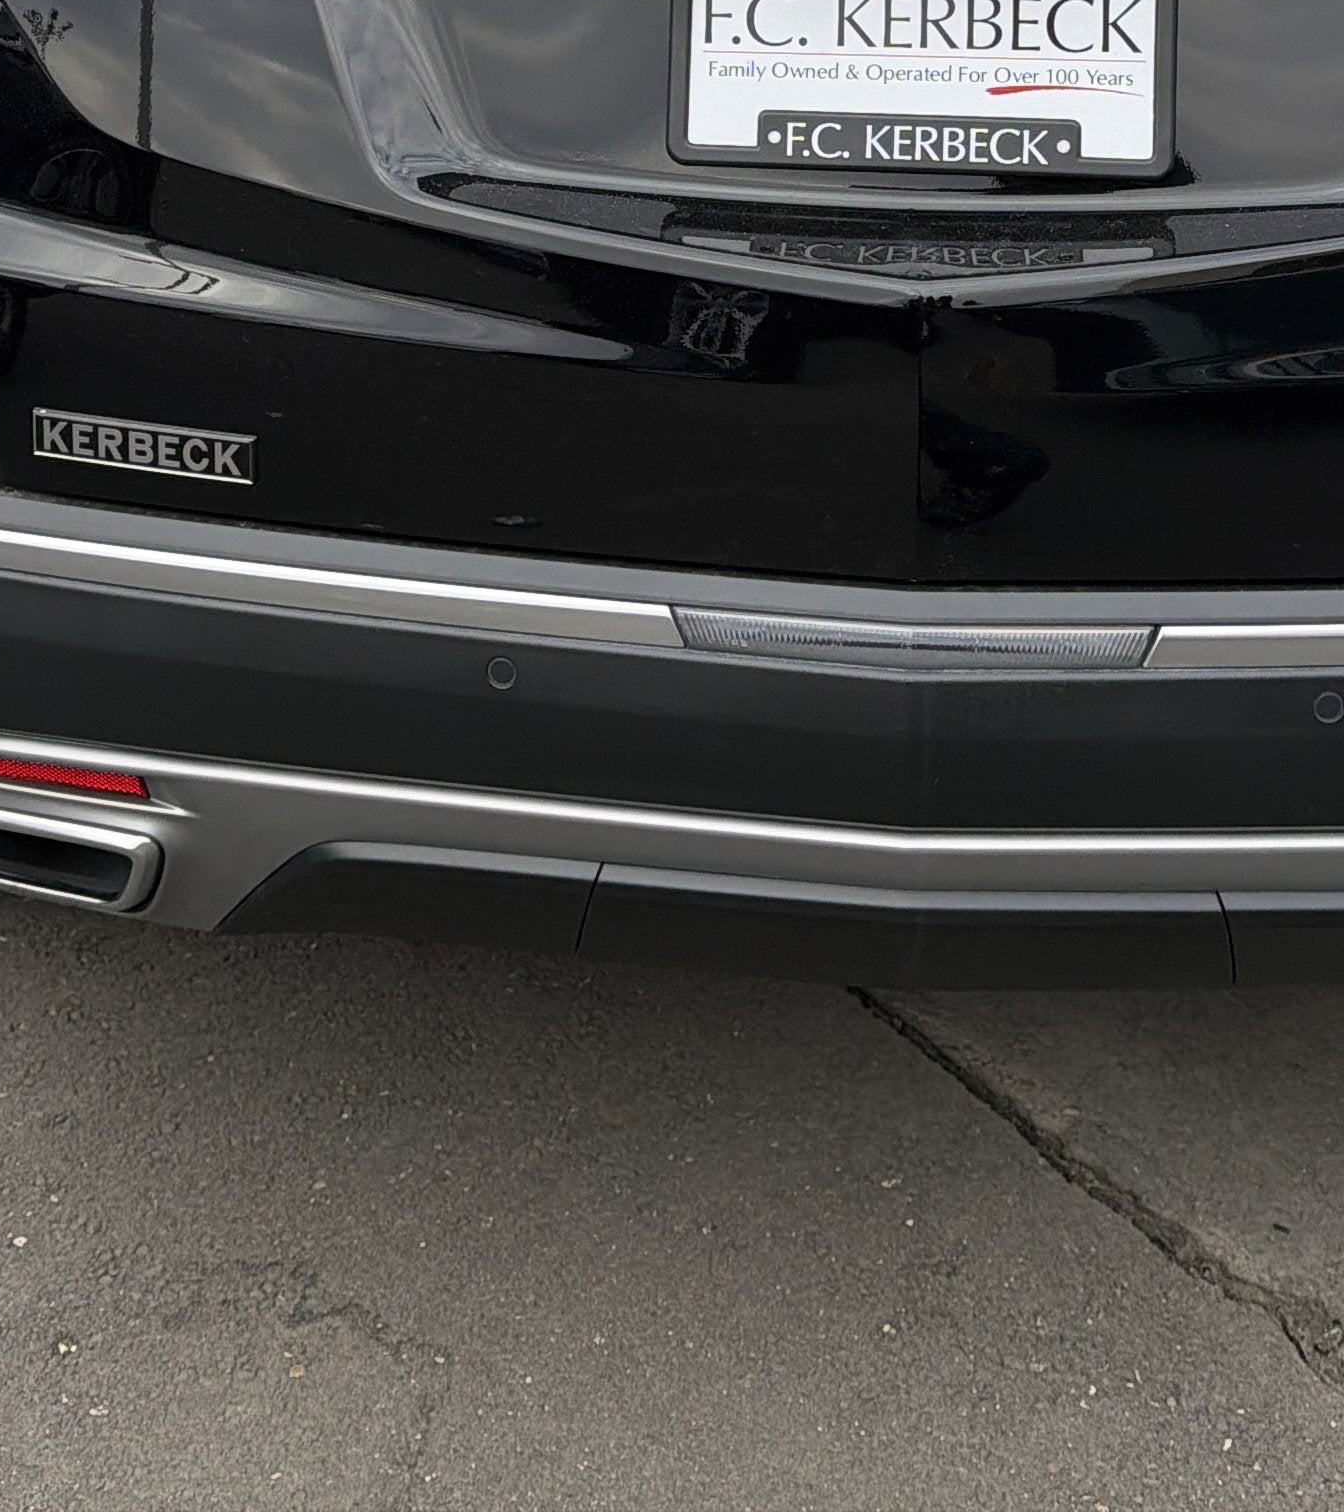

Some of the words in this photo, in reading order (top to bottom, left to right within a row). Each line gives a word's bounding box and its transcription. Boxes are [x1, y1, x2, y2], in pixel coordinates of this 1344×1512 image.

[708, 60, 766, 81] Family
[771, 61, 839, 80] Owned
[846, 64, 859, 80] &
[865, 63, 952, 84] Operated
[958, 66, 988, 83] For
[994, 66, 1039, 84] Over
[1045, 68, 1079, 85] 100
[1086, 69, 1134, 86] Years
[786, 122, 850, 159] F.C.
[864, 124, 1049, 165] KERBECK
[43, 419, 242, 477] KERBECK
